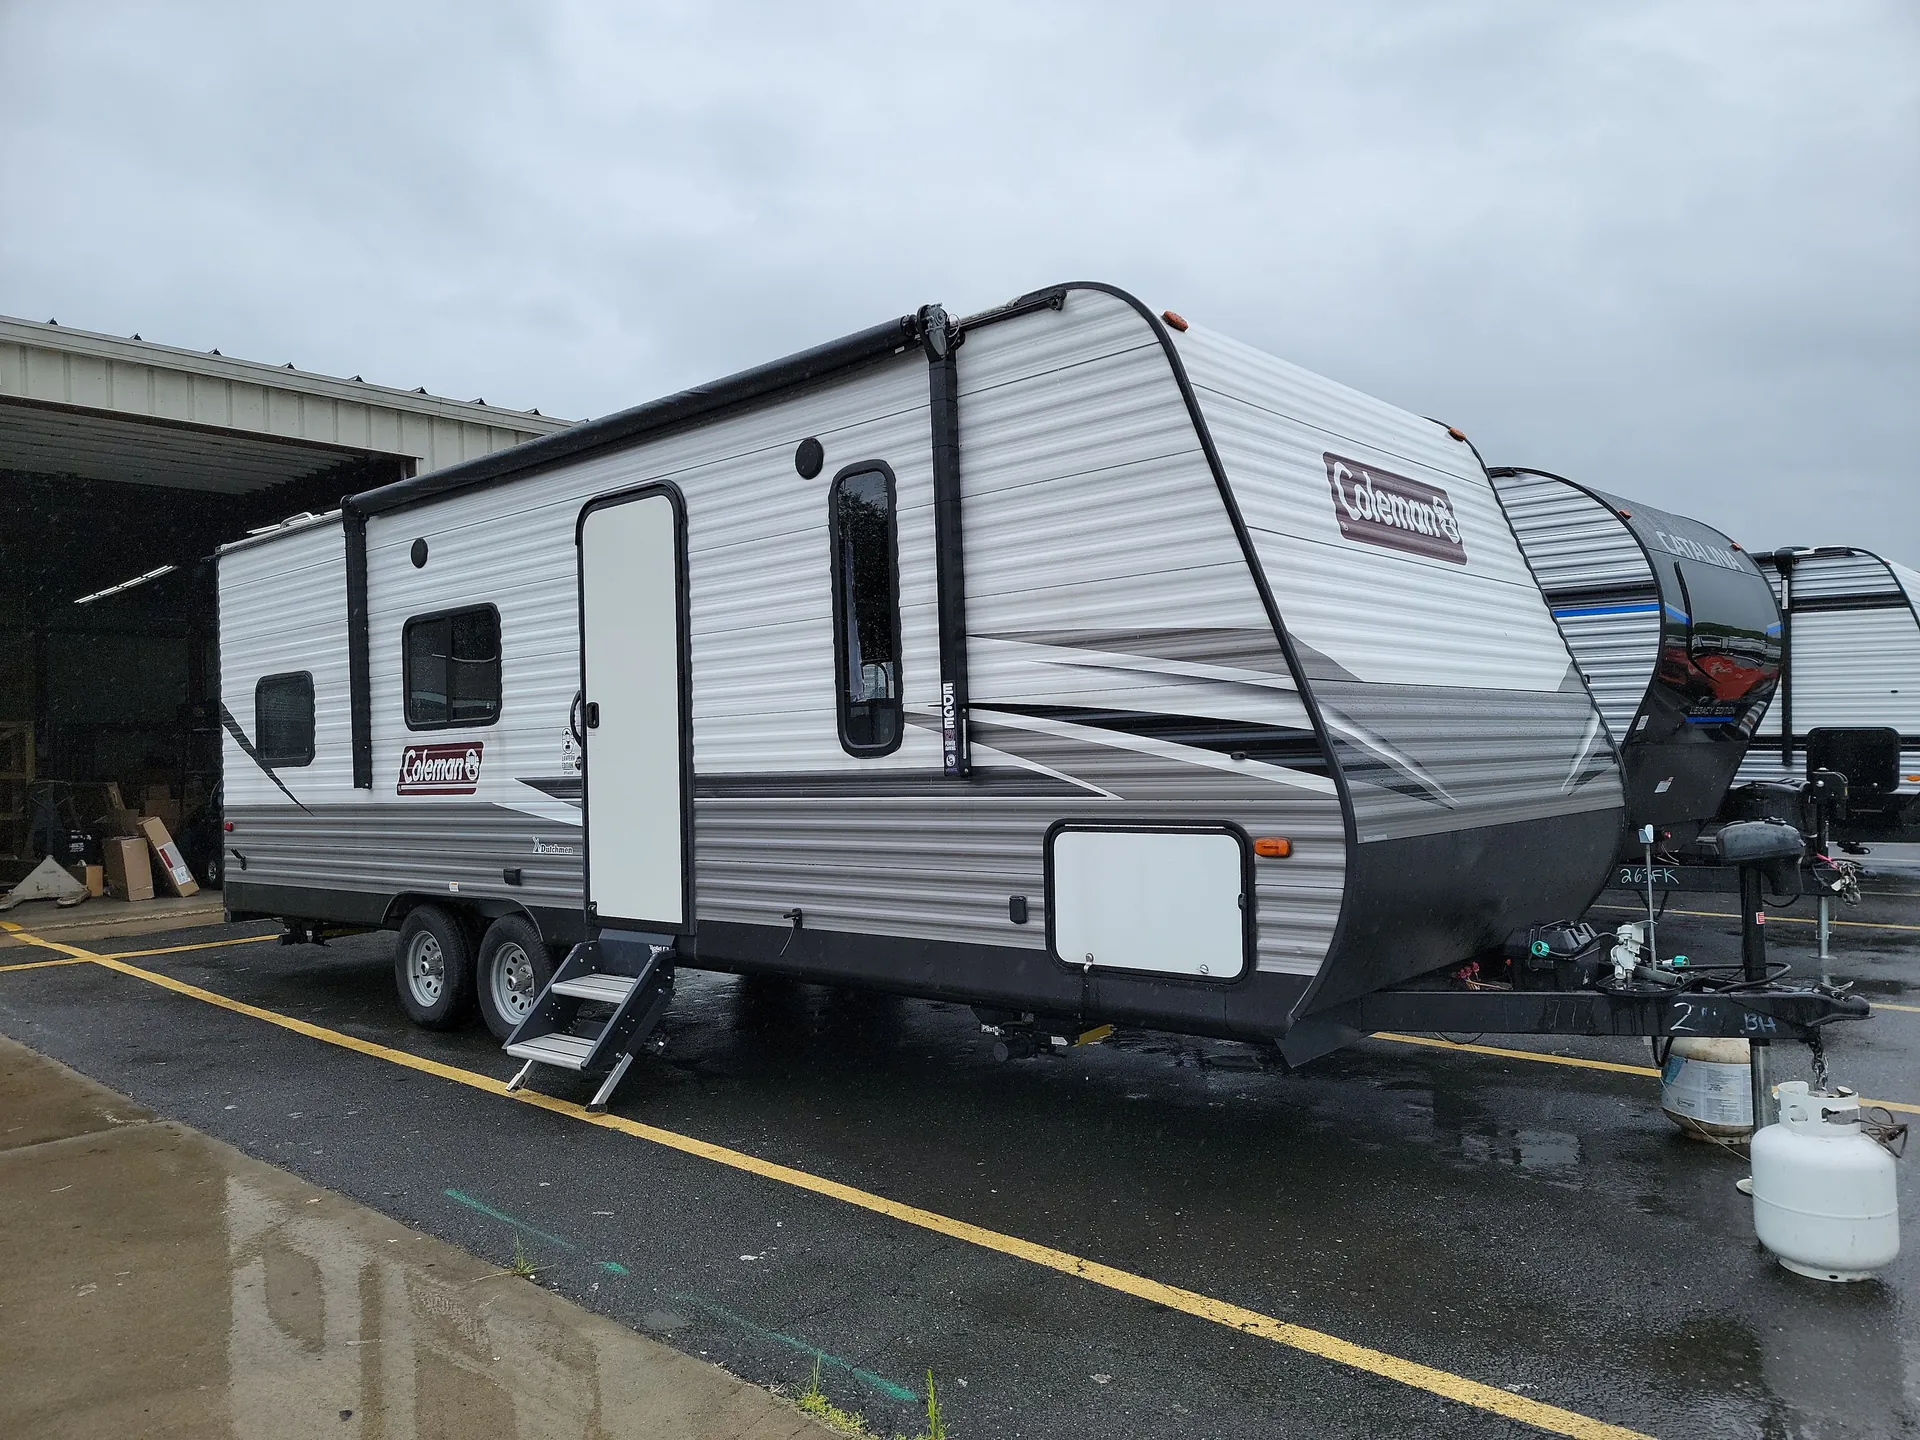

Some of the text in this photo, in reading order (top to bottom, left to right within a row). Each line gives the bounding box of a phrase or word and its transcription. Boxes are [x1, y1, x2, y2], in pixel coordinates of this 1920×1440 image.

[1333, 461, 1441, 538] Coleman
[1655, 530, 1745, 571] CATALINA
[942, 682, 955, 729] EDGE
[403, 749, 464, 784] Coleman
[540, 843, 574, 855] Dutchmen
